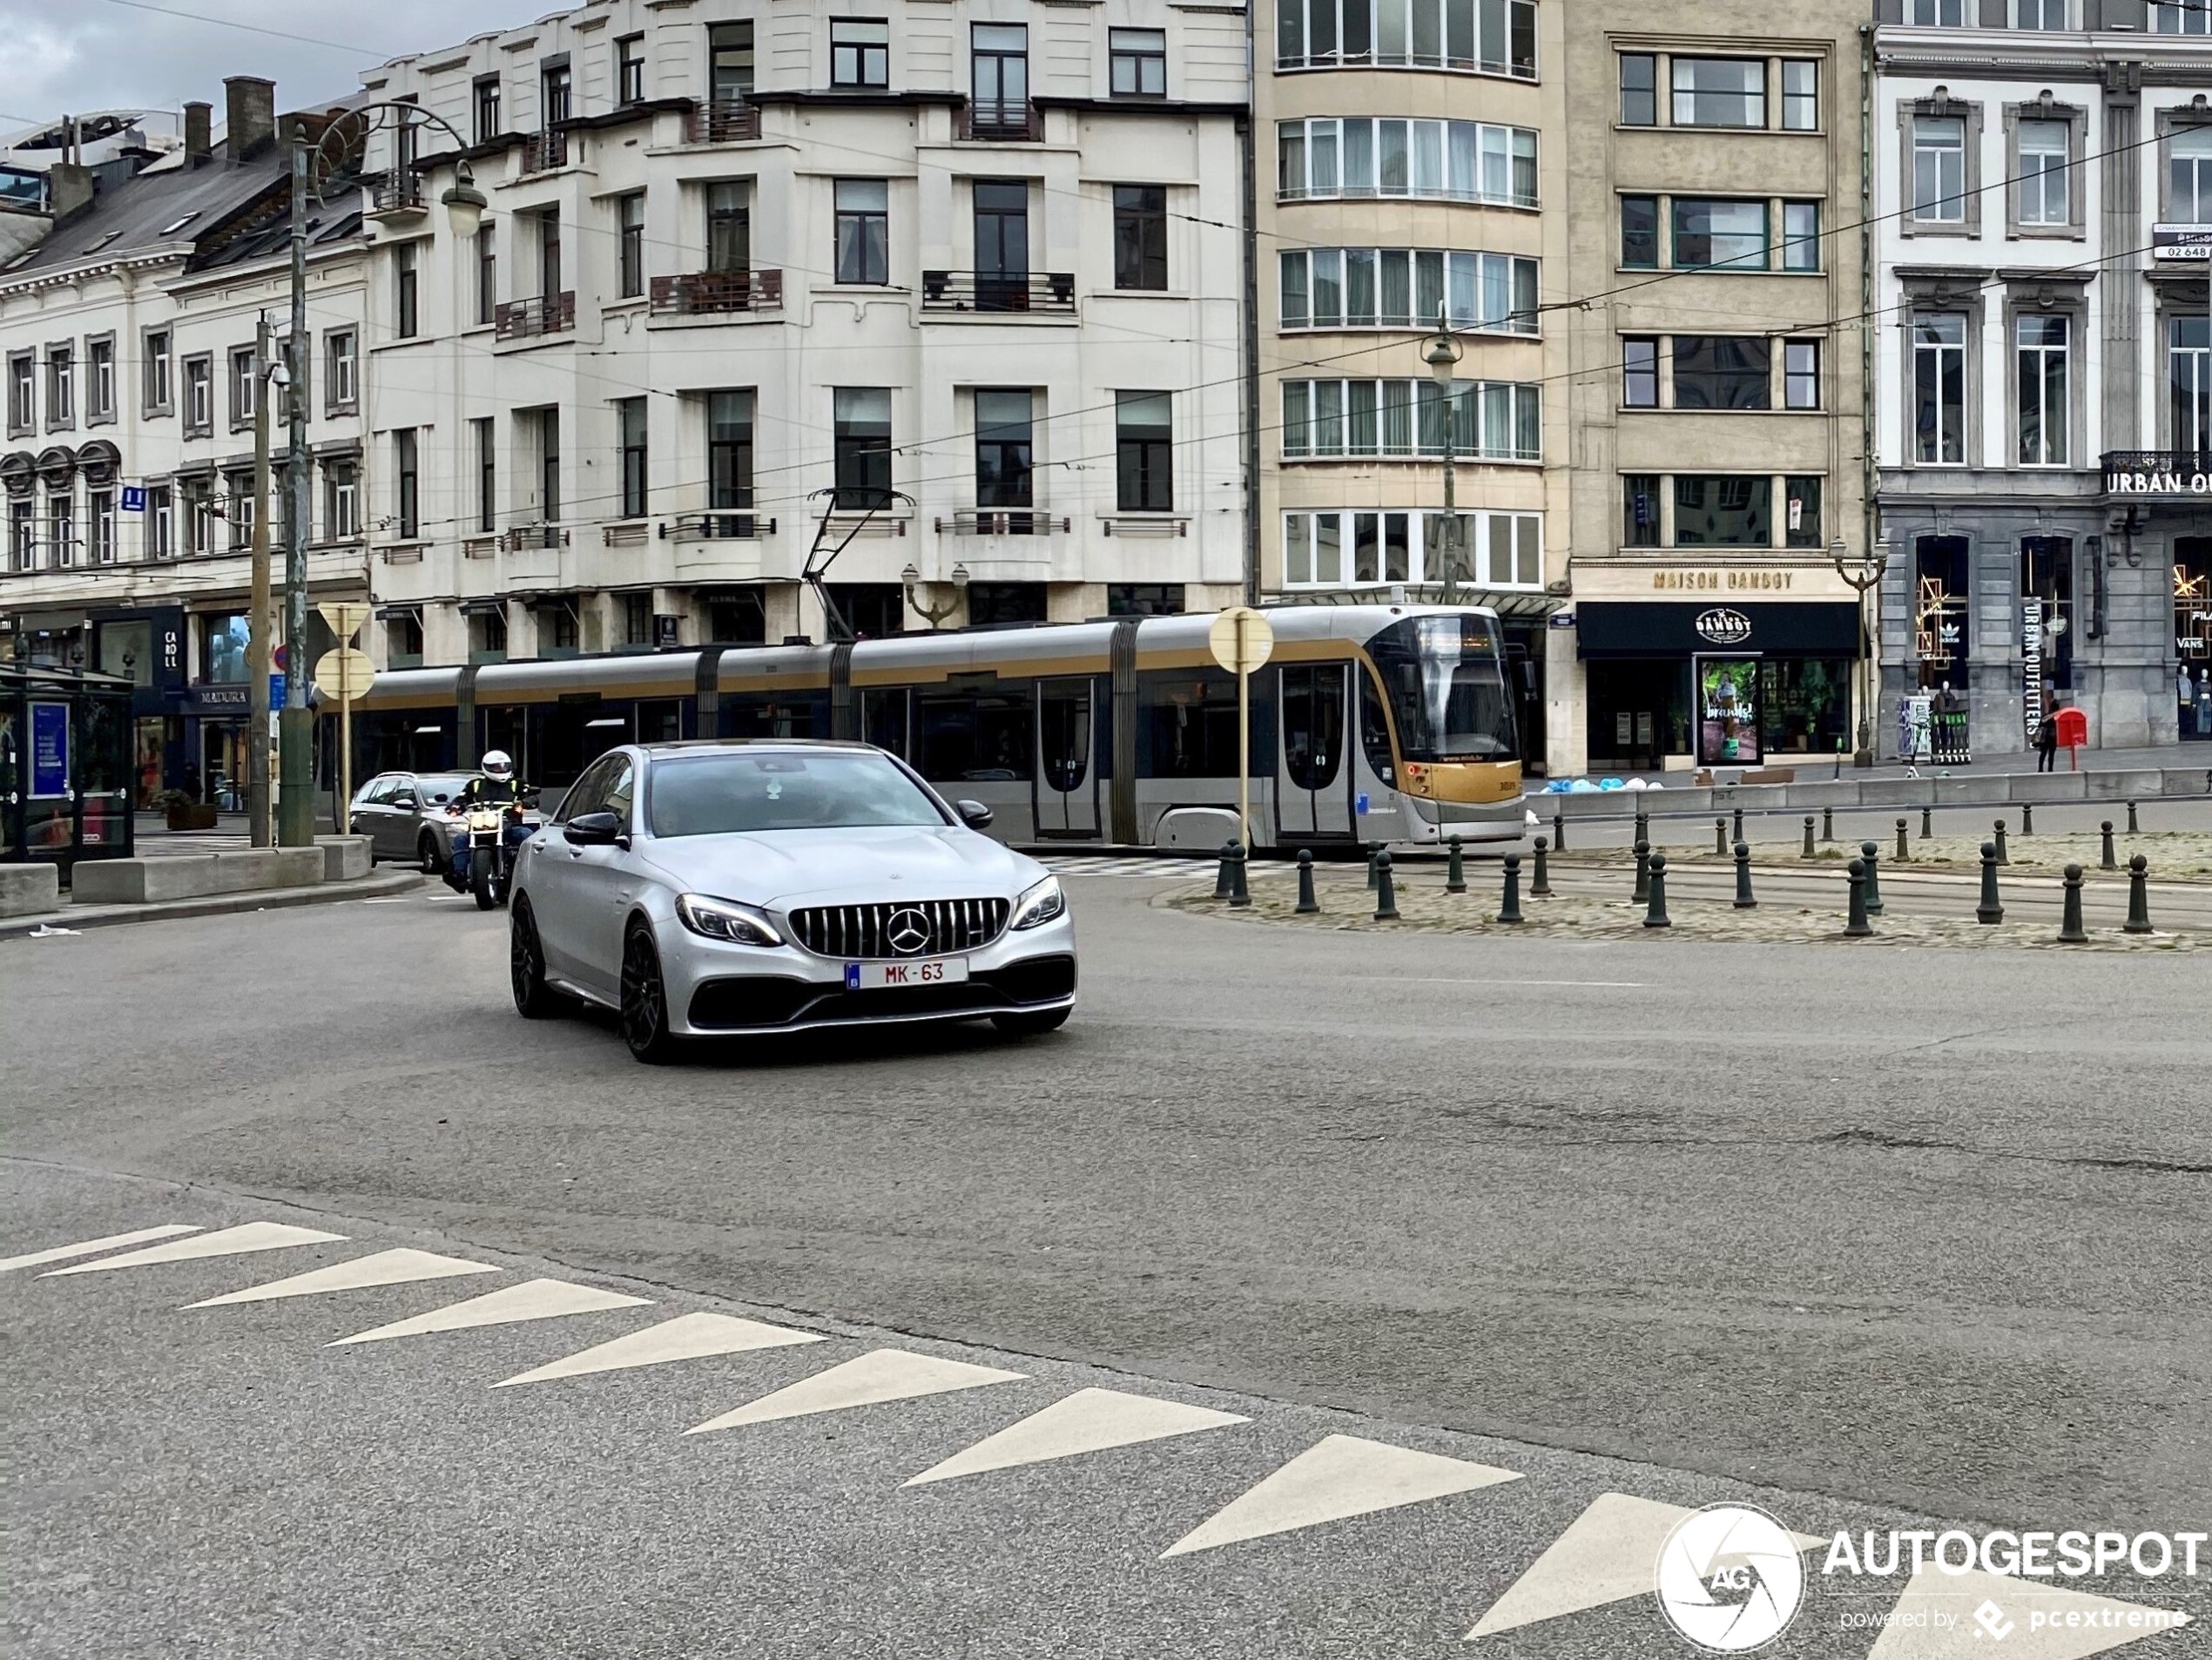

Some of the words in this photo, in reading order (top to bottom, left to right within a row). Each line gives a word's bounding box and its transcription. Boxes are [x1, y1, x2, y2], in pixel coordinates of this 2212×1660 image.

[2168, 247, 2182, 256] 02
[2185, 247, 2206, 256] 648
[2107, 473, 2181, 493] URBAN
[1654, 572, 1717, 589] MAISON
[1728, 572, 1792, 589] DANDOY
[2025, 605, 2040, 651] URBAN
[2176, 638, 2203, 648] VANS
[2026, 656, 2041, 735] OUTFITTERS
[850, 978, 858, 987] B
